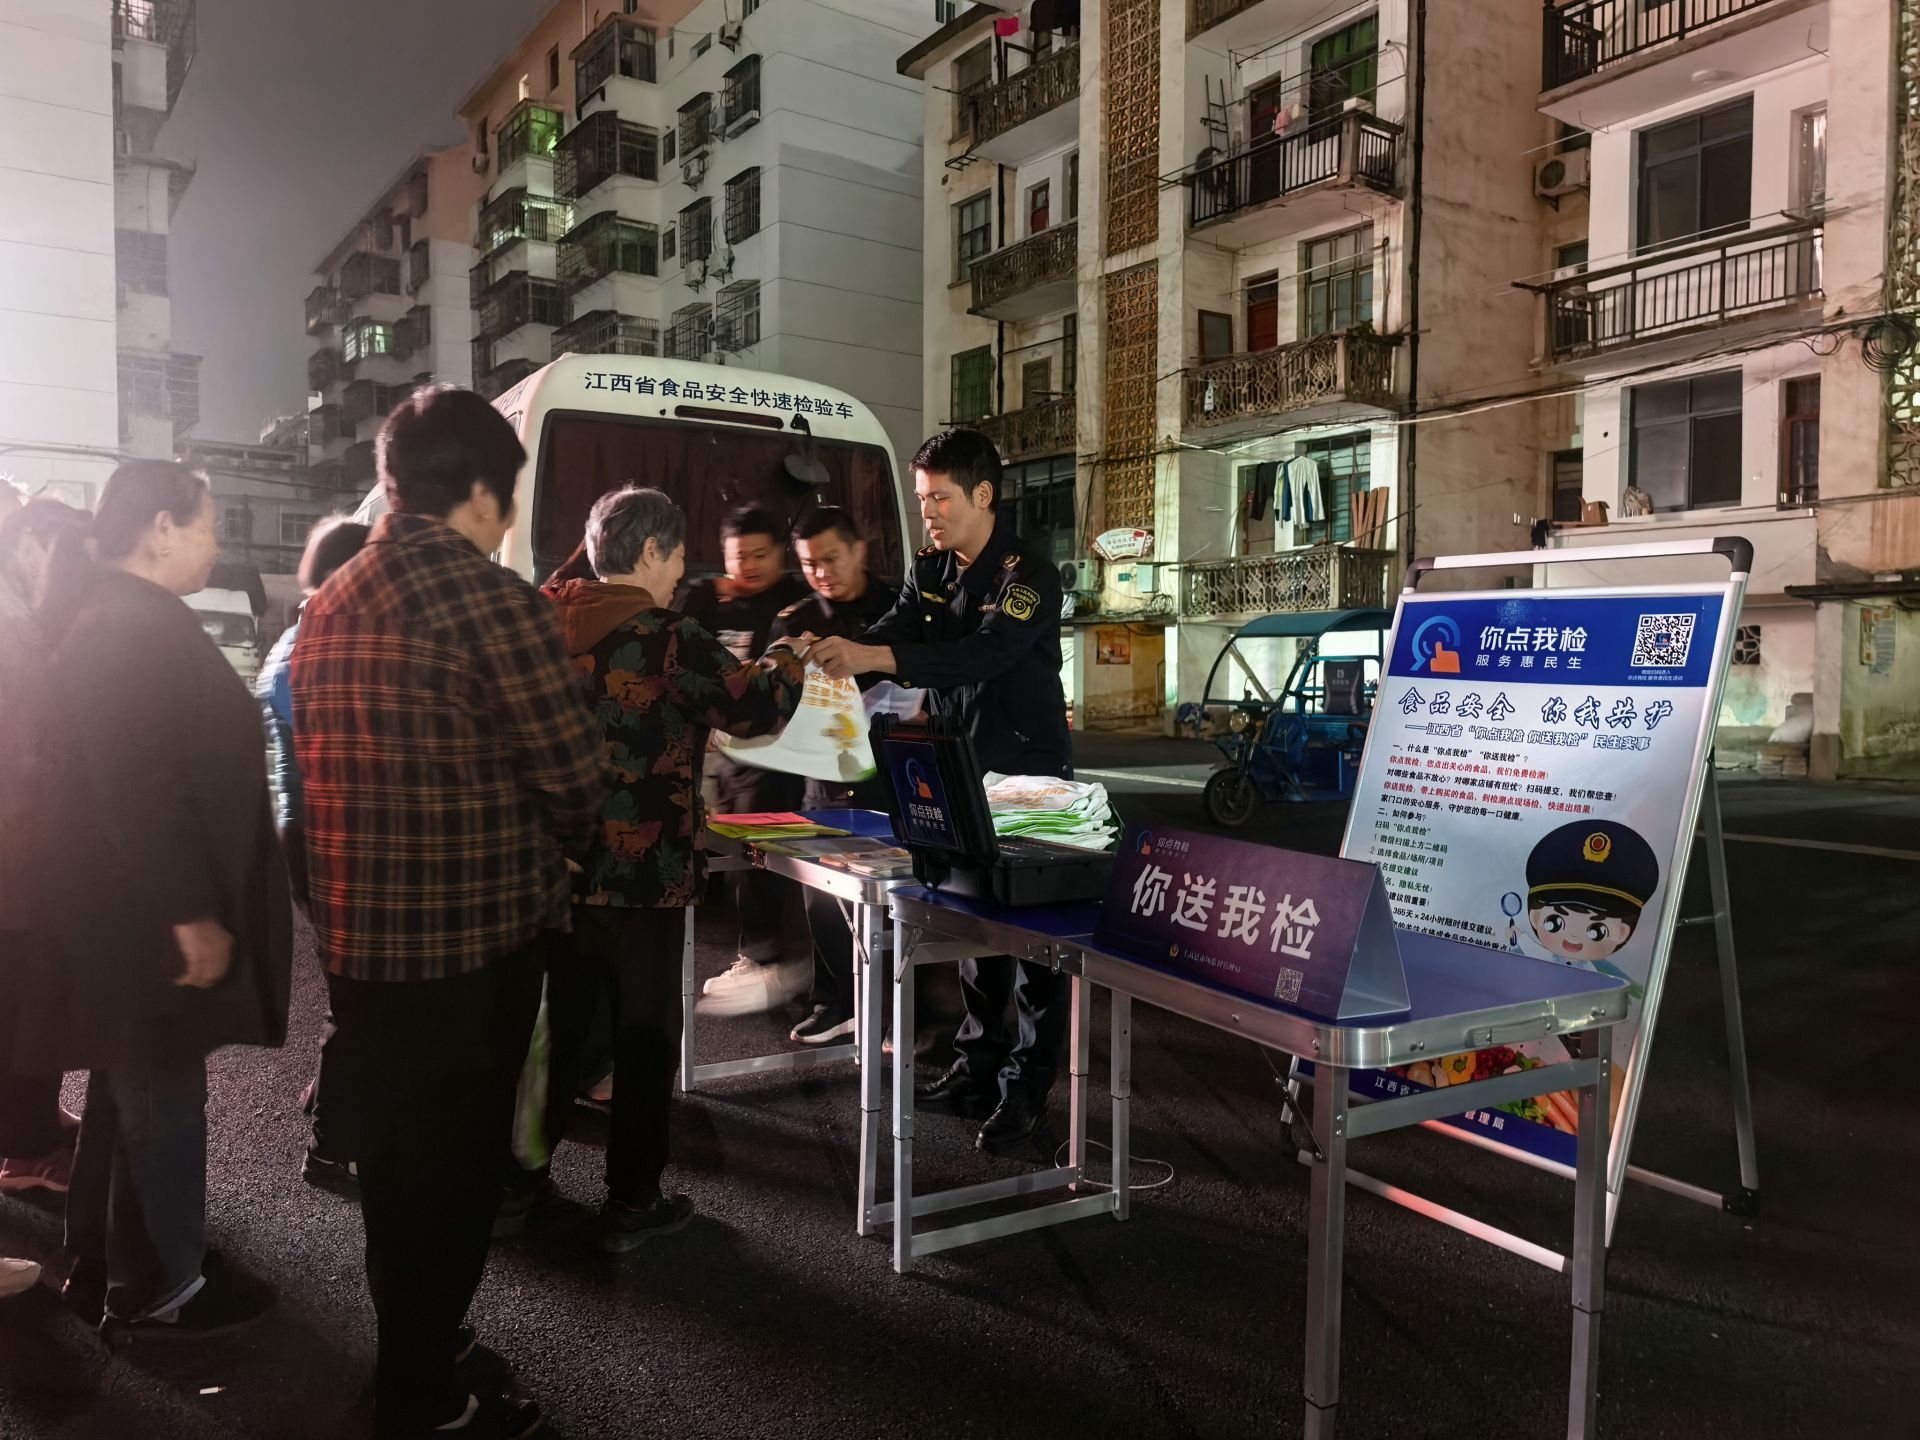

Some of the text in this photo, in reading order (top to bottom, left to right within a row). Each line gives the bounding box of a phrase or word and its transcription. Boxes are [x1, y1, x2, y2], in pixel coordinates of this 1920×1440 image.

[584, 371, 854, 419] 江西省食品安全快速检验车
[1479, 625, 1588, 652] 你点我检
[1475, 654, 1582, 669] 服务惠民生
[1398, 686, 1673, 730] 食品安全 你我共护
[909, 802, 944, 821] 你点我检
[1379, 862, 1419, 877] 名提交建议
[1383, 875, 1433, 893] 名，隐私无忧！
[1387, 891, 1430, 907] 建议很重要！
[1130, 863, 1321, 960] 你送我检
